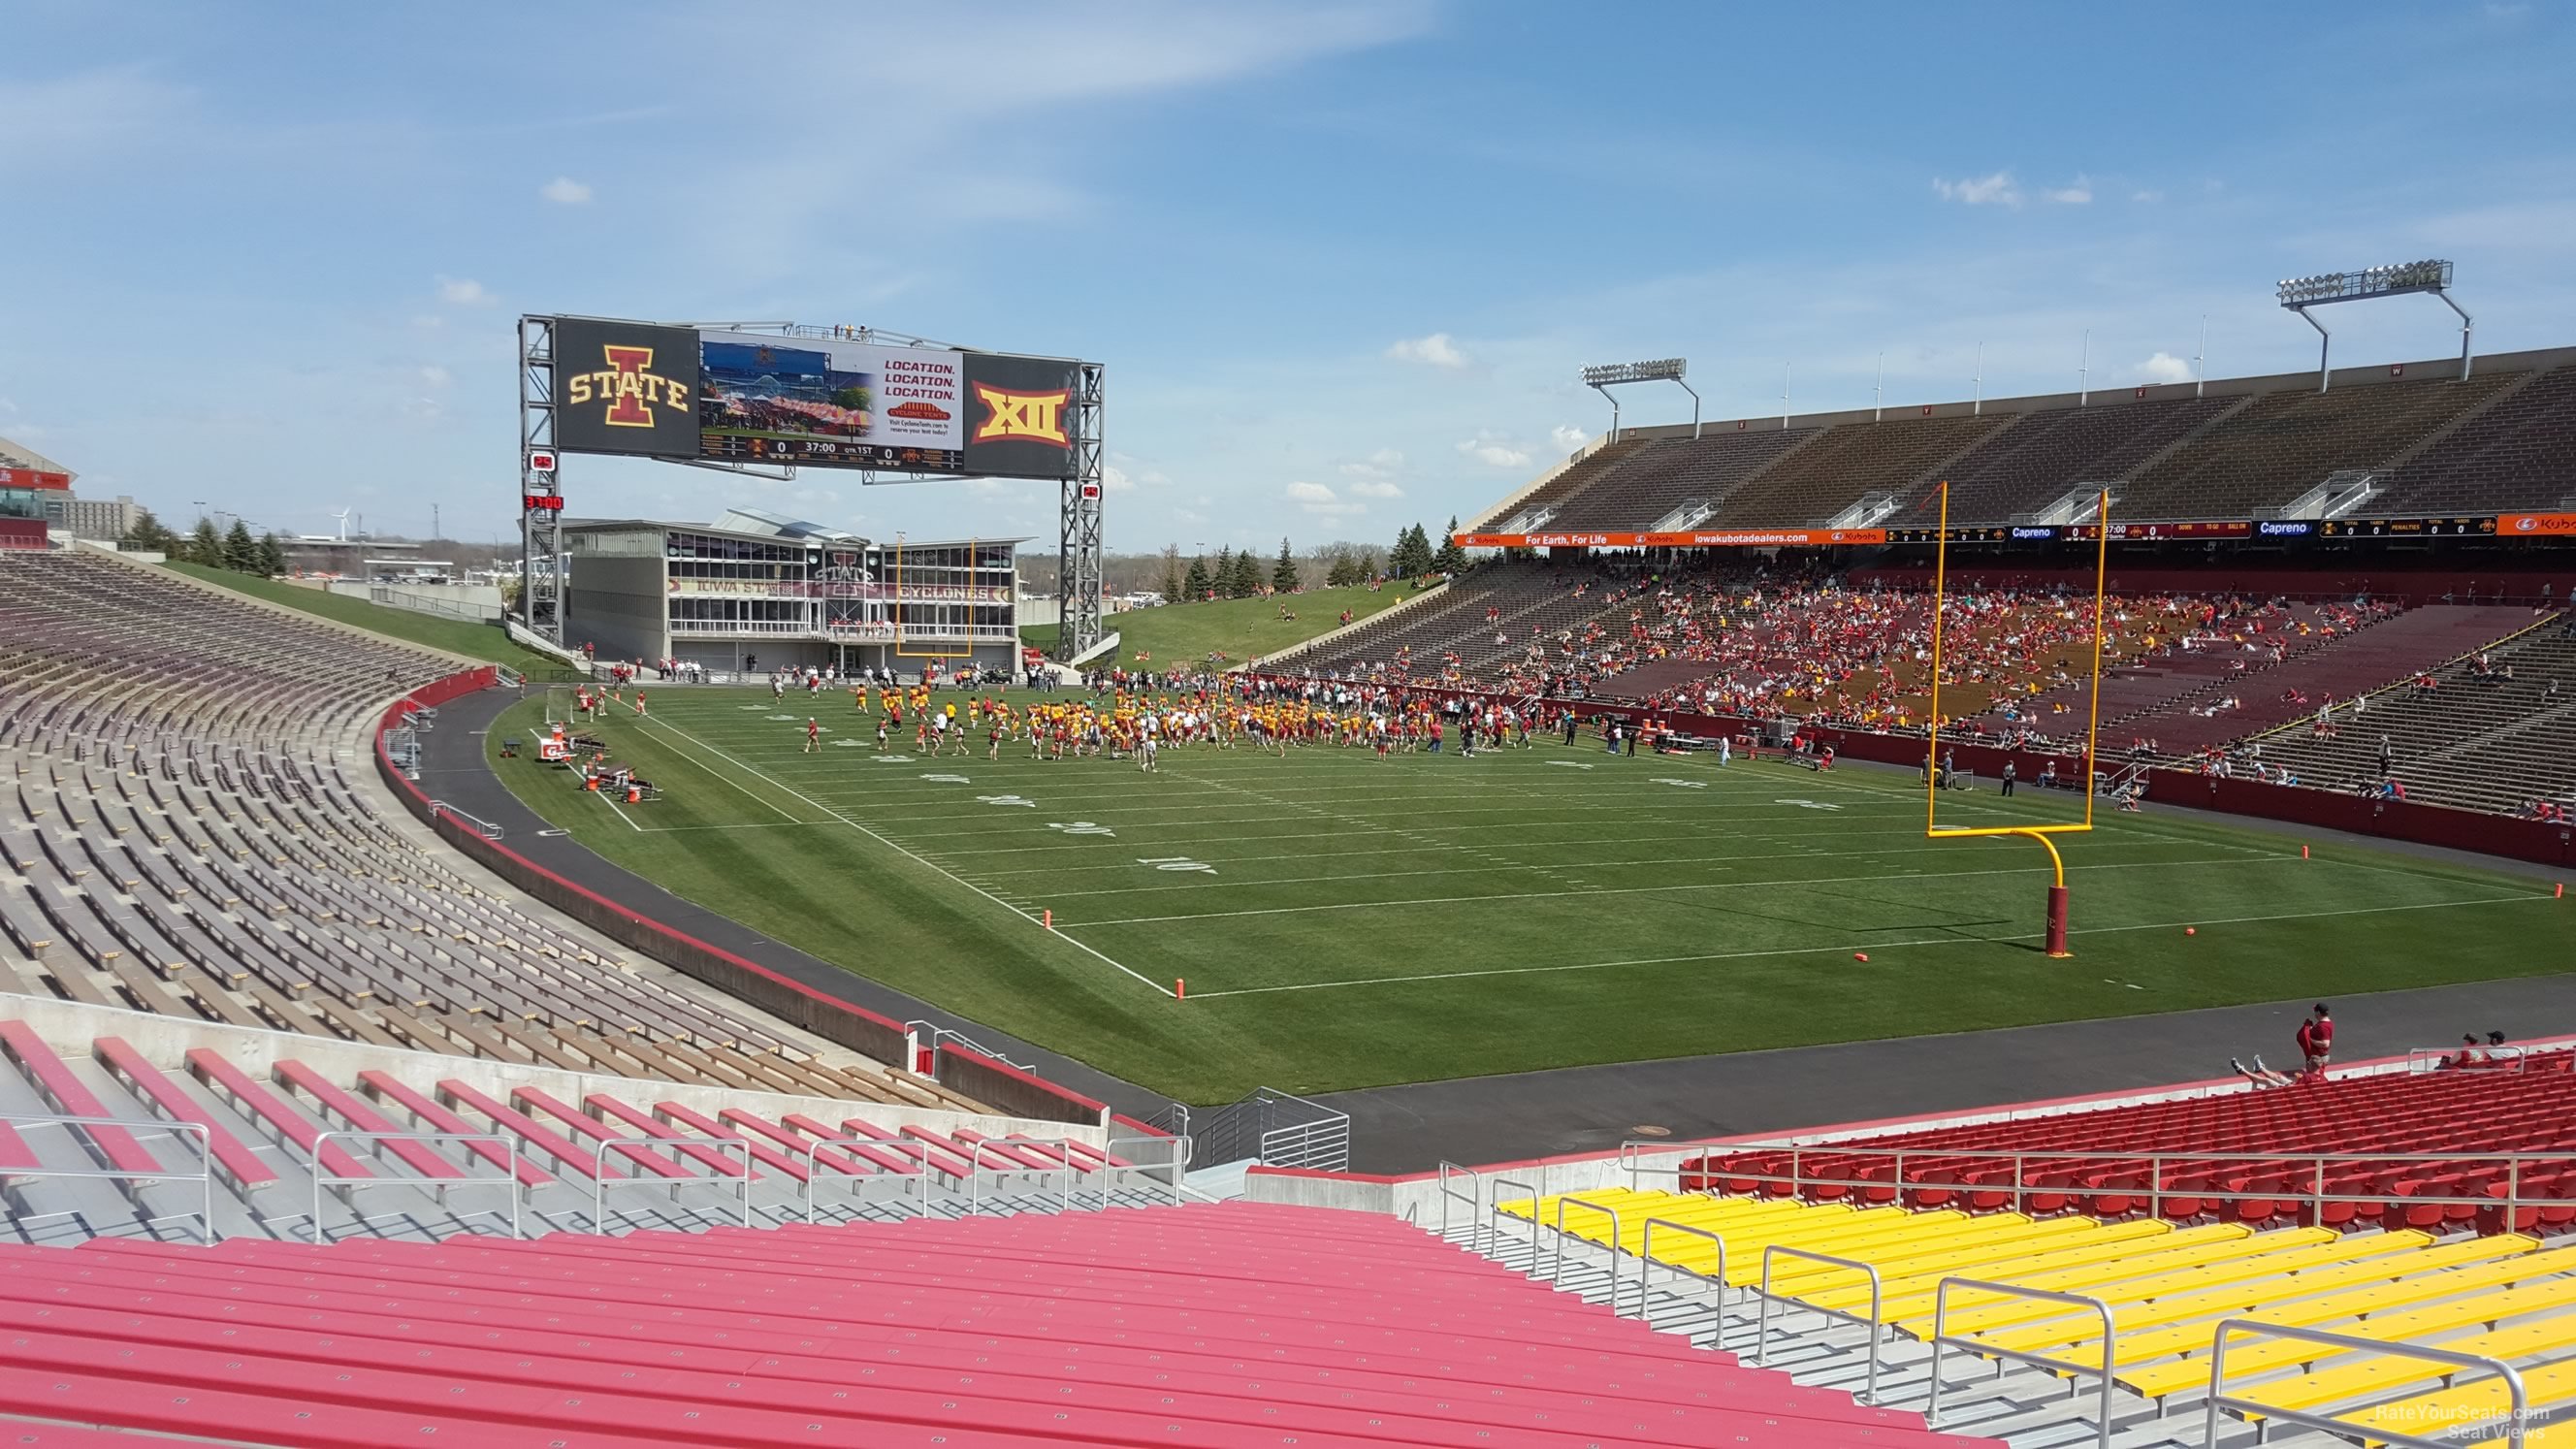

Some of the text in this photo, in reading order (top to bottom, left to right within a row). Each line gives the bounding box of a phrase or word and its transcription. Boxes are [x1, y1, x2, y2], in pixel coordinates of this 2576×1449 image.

[885, 360, 955, 374] LOCATION.
[885, 373, 955, 388] LOCATION.
[569, 371, 689, 412] STATE
[885, 386, 955, 401] LOCATION.
[979, 388, 1067, 443] XII
[778, 442, 787, 453] 0
[806, 441, 836, 453] 37:00
[857, 446, 872, 455] 1ST
[885, 449, 892, 459] 0
[535, 457, 552, 468] 25
[1085, 487, 1097, 497] 25
[527, 496, 562, 508] 37:00
[2012, 527, 2050, 537] Capreno
[2073, 528, 2078, 536] 0
[2149, 527, 2156, 535] 0
[2261, 522, 2306, 534] Capreno
[2348, 527, 2354, 535] 0
[2458, 525, 2464, 533] 0
[1526, 534, 1607, 545] For Earth, For Life
[815, 565, 875, 587] STATE
[899, 587, 988, 599] CYCLONES
[1137, 856, 1211, 871] 10
